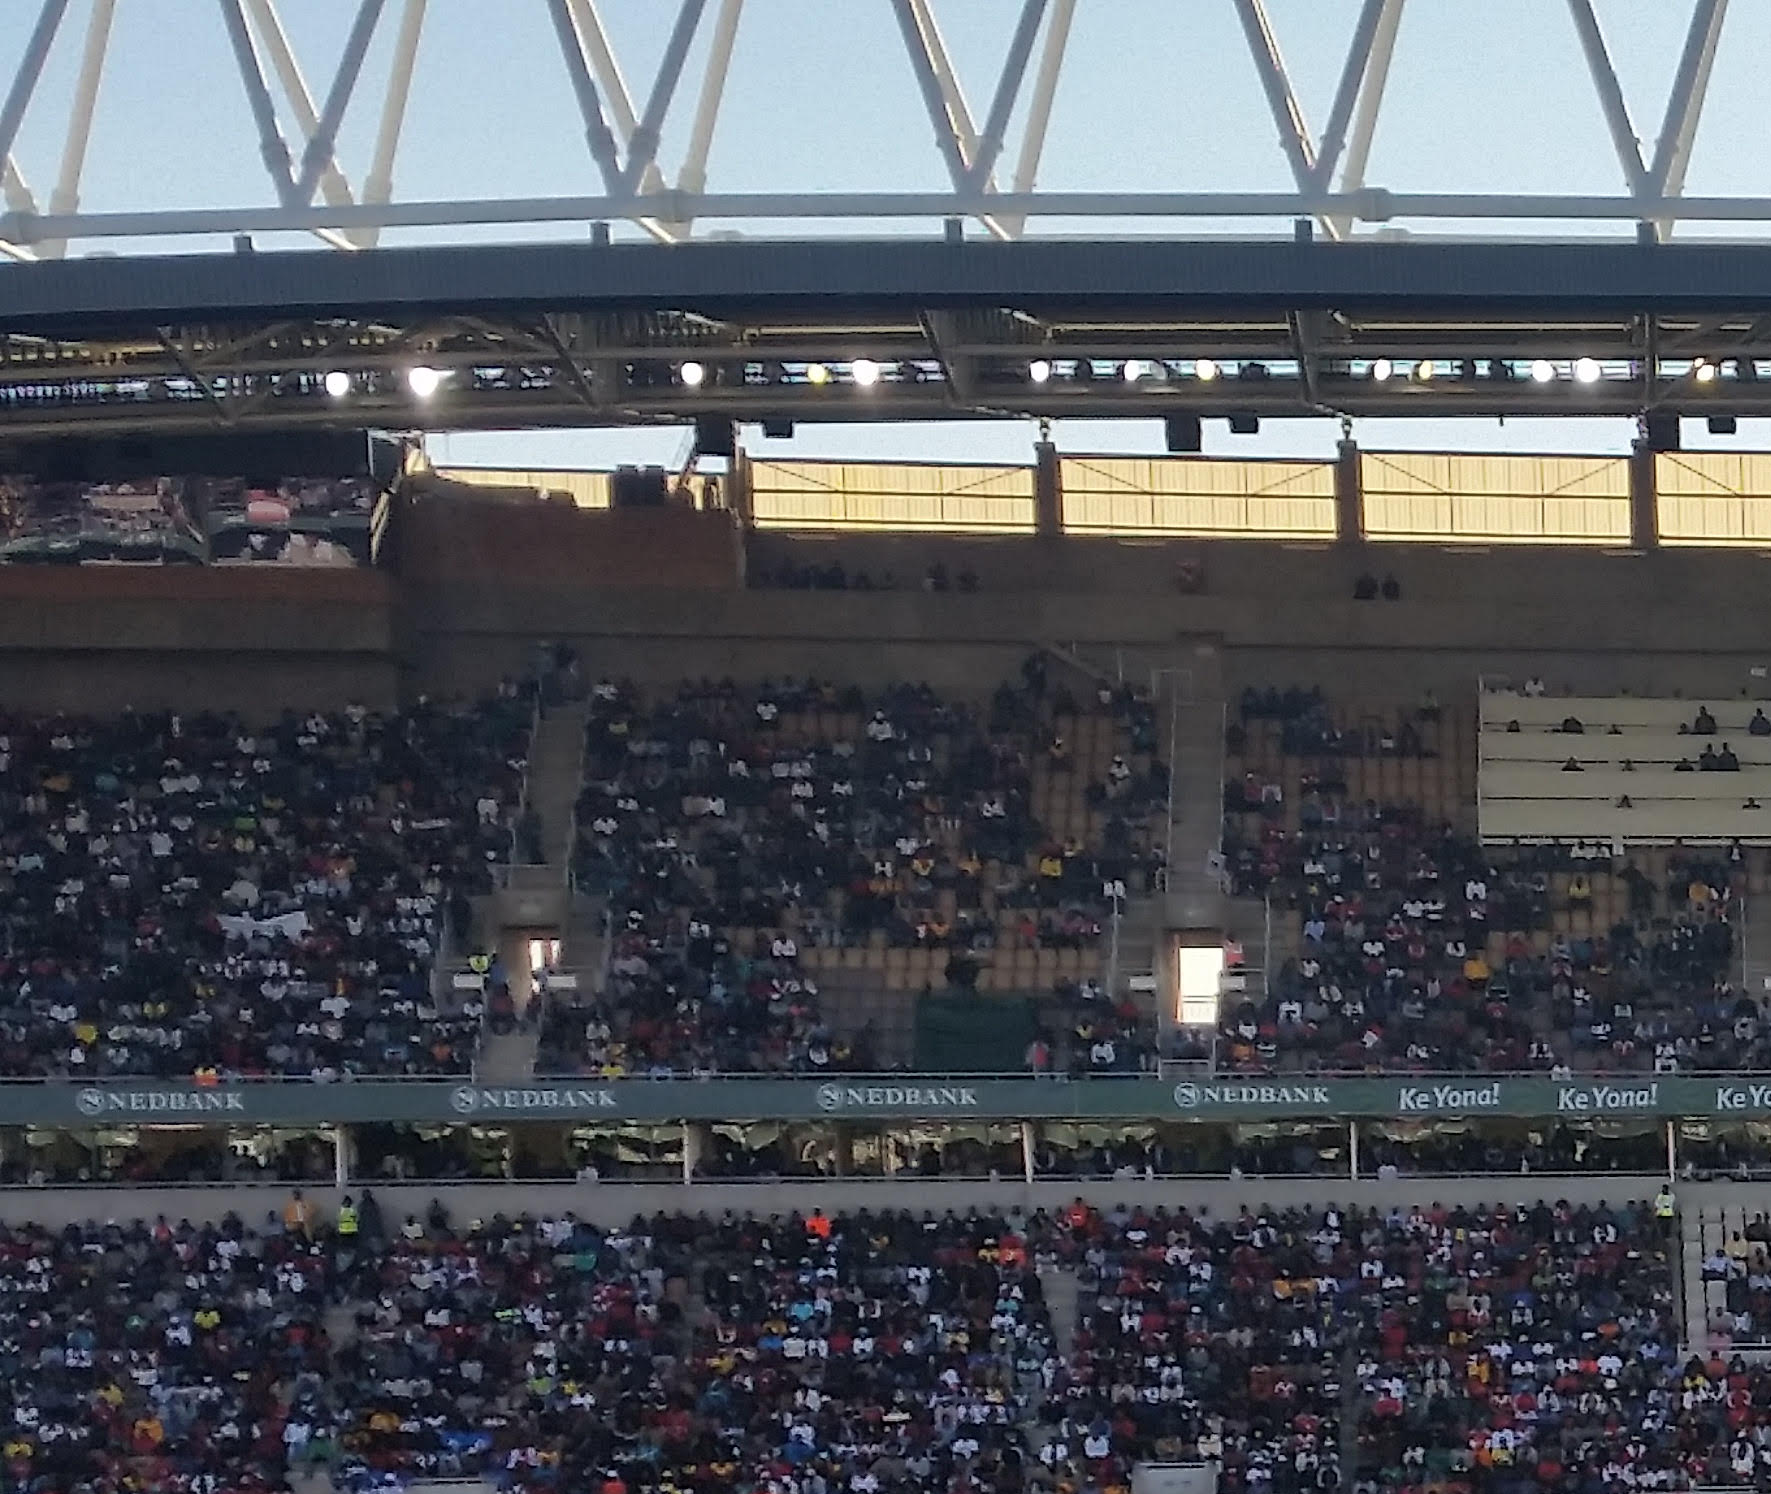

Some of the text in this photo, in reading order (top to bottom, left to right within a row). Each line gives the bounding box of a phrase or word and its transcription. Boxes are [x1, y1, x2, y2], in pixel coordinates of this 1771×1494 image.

[108, 1091, 244, 1113] NEDBANK
[482, 1089, 617, 1109] NEDBANK
[847, 1086, 978, 1106] NEDBANK
[1203, 1085, 1330, 1105] NEDBANK
[1399, 1082, 1500, 1110] Ke Yona!
[1558, 1083, 1658, 1109] Ke Yona!
[1716, 1086, 1747, 1109] Ke
